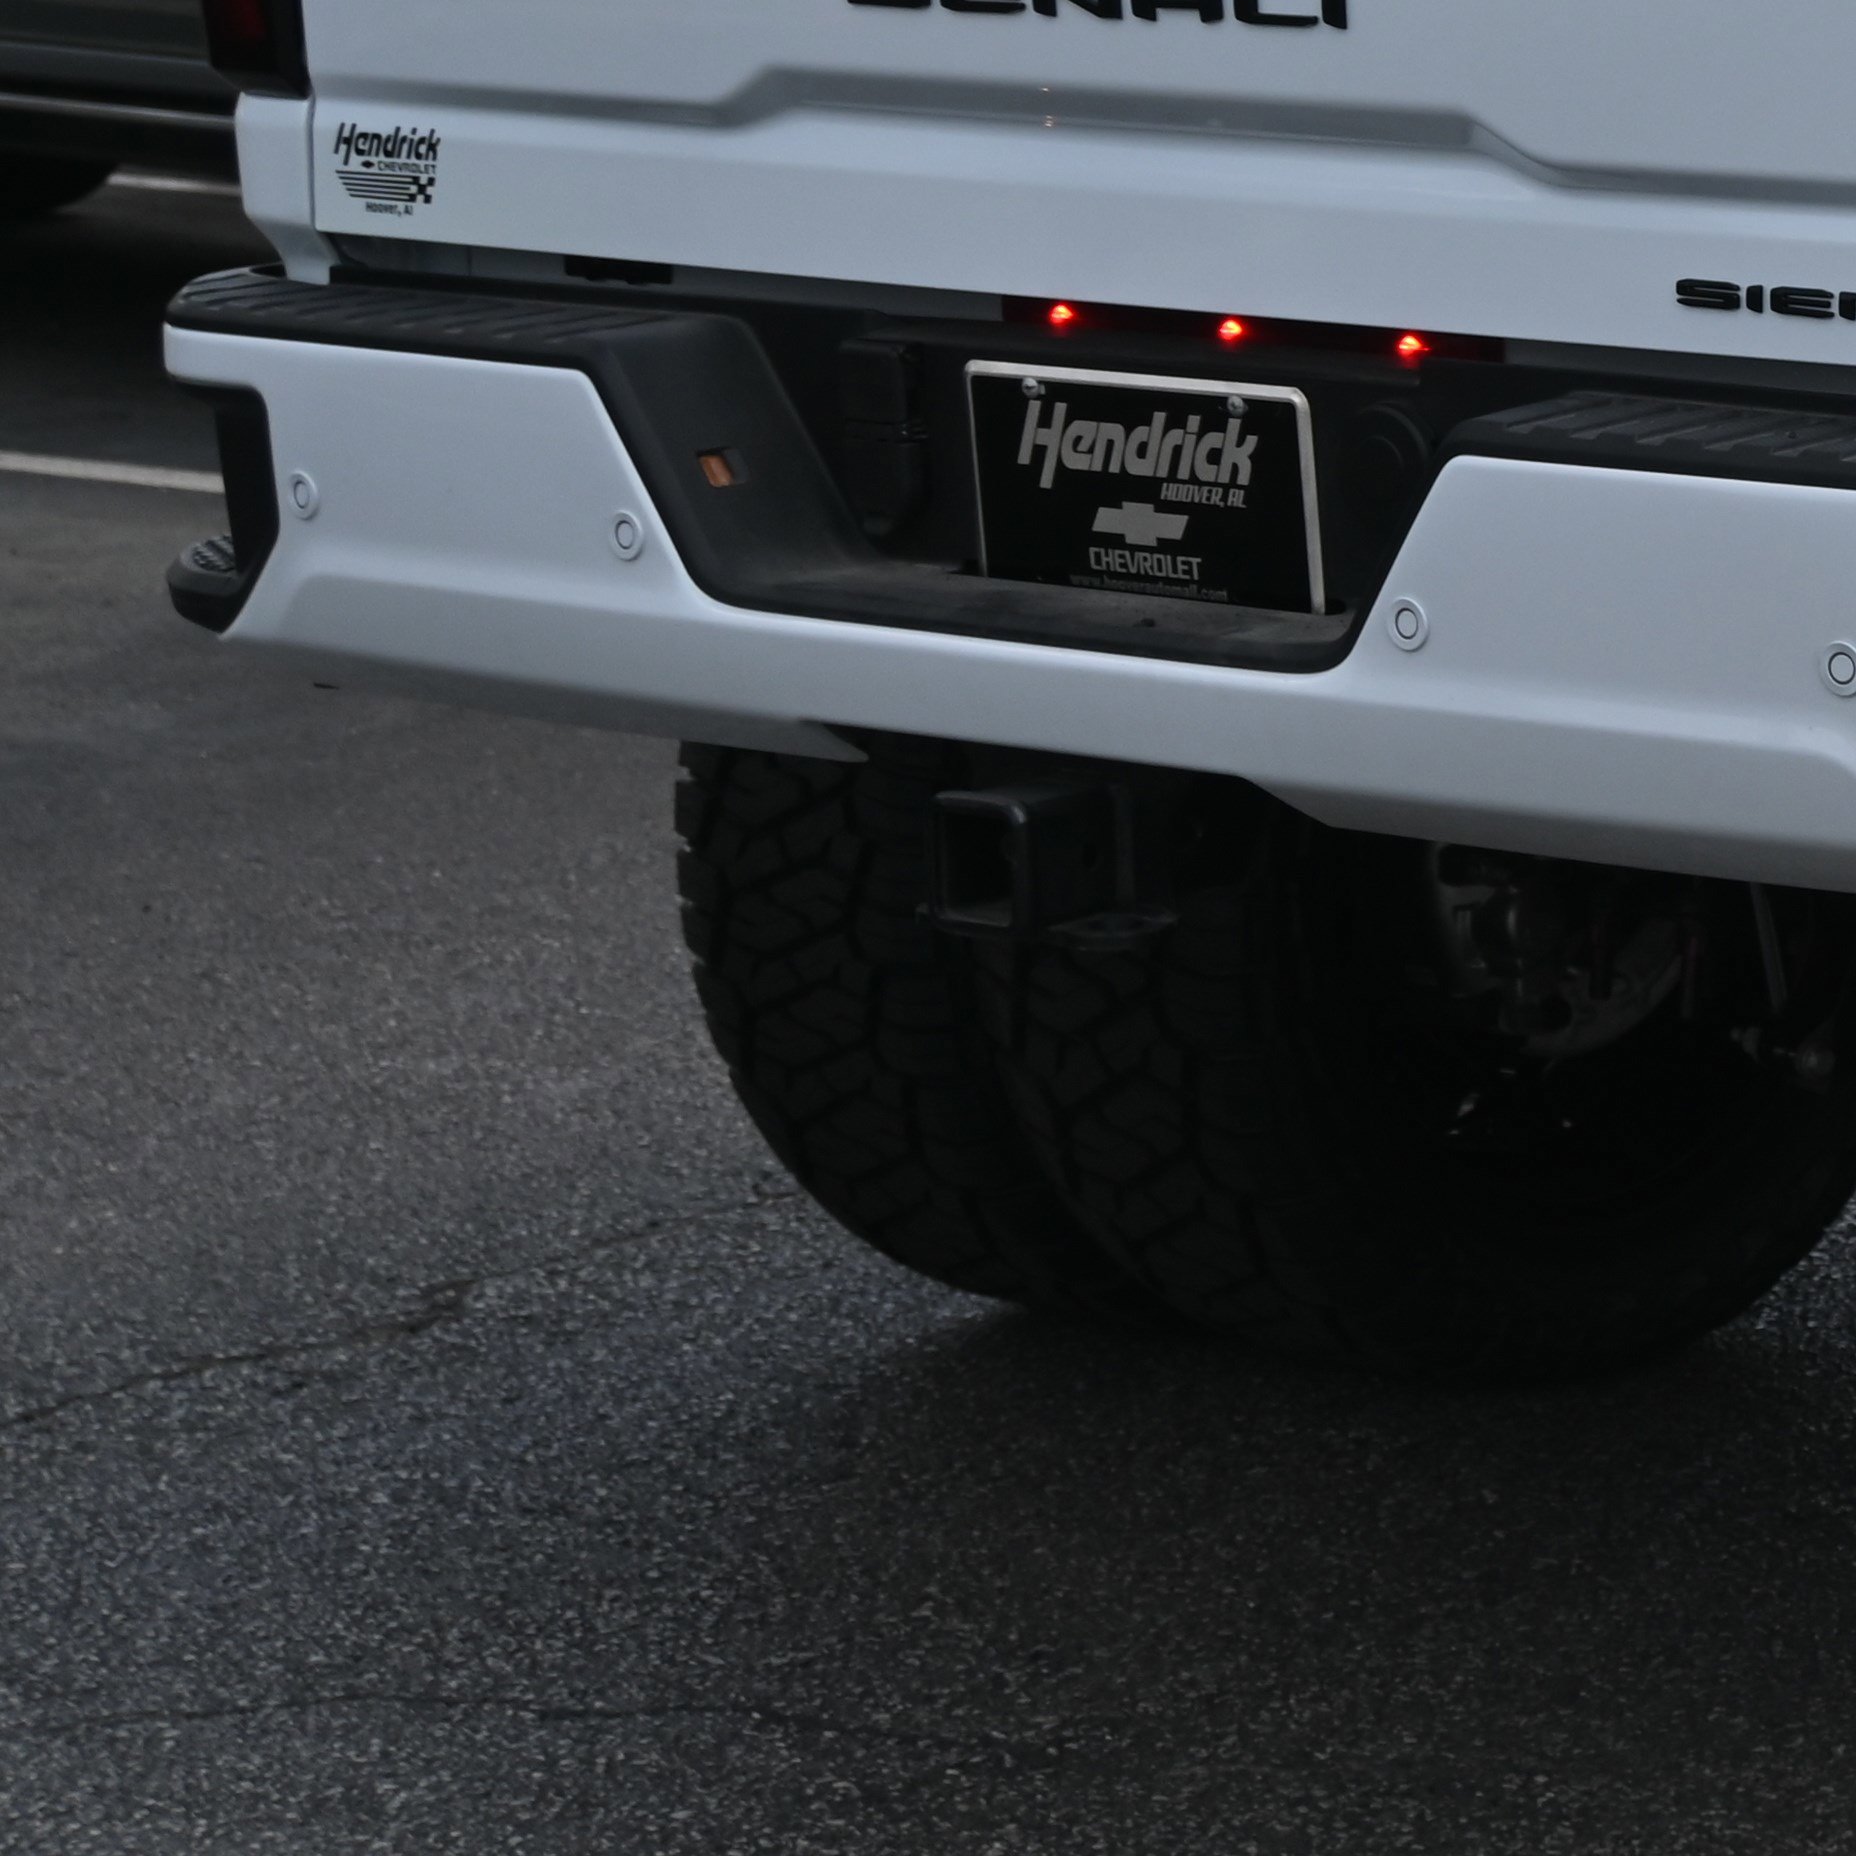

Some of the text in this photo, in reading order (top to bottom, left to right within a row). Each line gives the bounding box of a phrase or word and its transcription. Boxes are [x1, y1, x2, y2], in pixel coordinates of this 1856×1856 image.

[333, 122, 441, 166] Hendrick
[377, 160, 437, 175] CHEVROLET
[1017, 399, 1259, 489] Hendrick
[1160, 482, 1247, 508] HOOVER, AL
[1088, 546, 1202, 580] CHEVROLET
